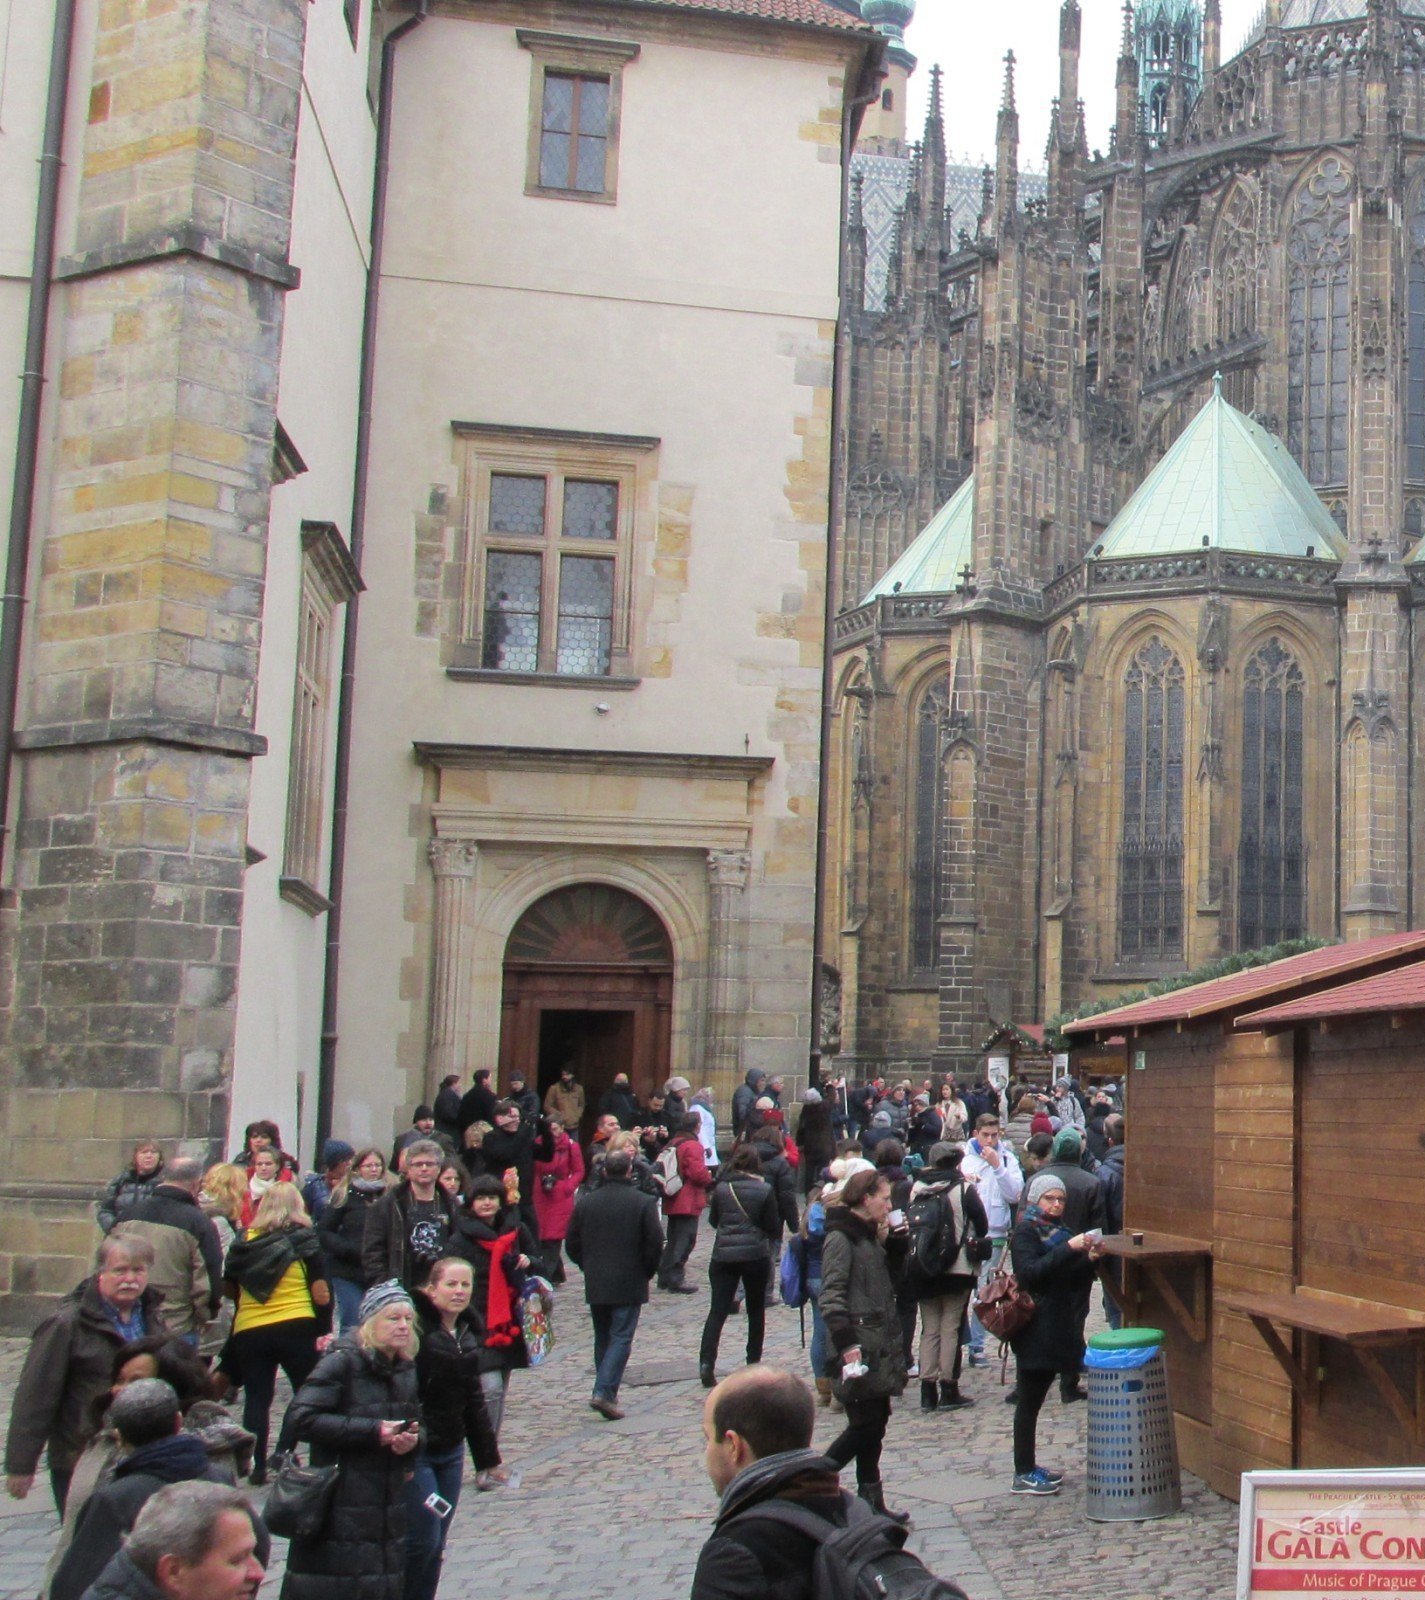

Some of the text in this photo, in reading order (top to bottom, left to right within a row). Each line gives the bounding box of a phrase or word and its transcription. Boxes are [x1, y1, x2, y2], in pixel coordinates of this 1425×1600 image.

[1299, 1516, 1362, 1536] Castle
[1267, 1530, 1351, 1560] GALA
[1303, 1574, 1347, 1588] Music
[1349, 1573, 1365, 1588] of
[1368, 1574, 1418, 1591] Prague
